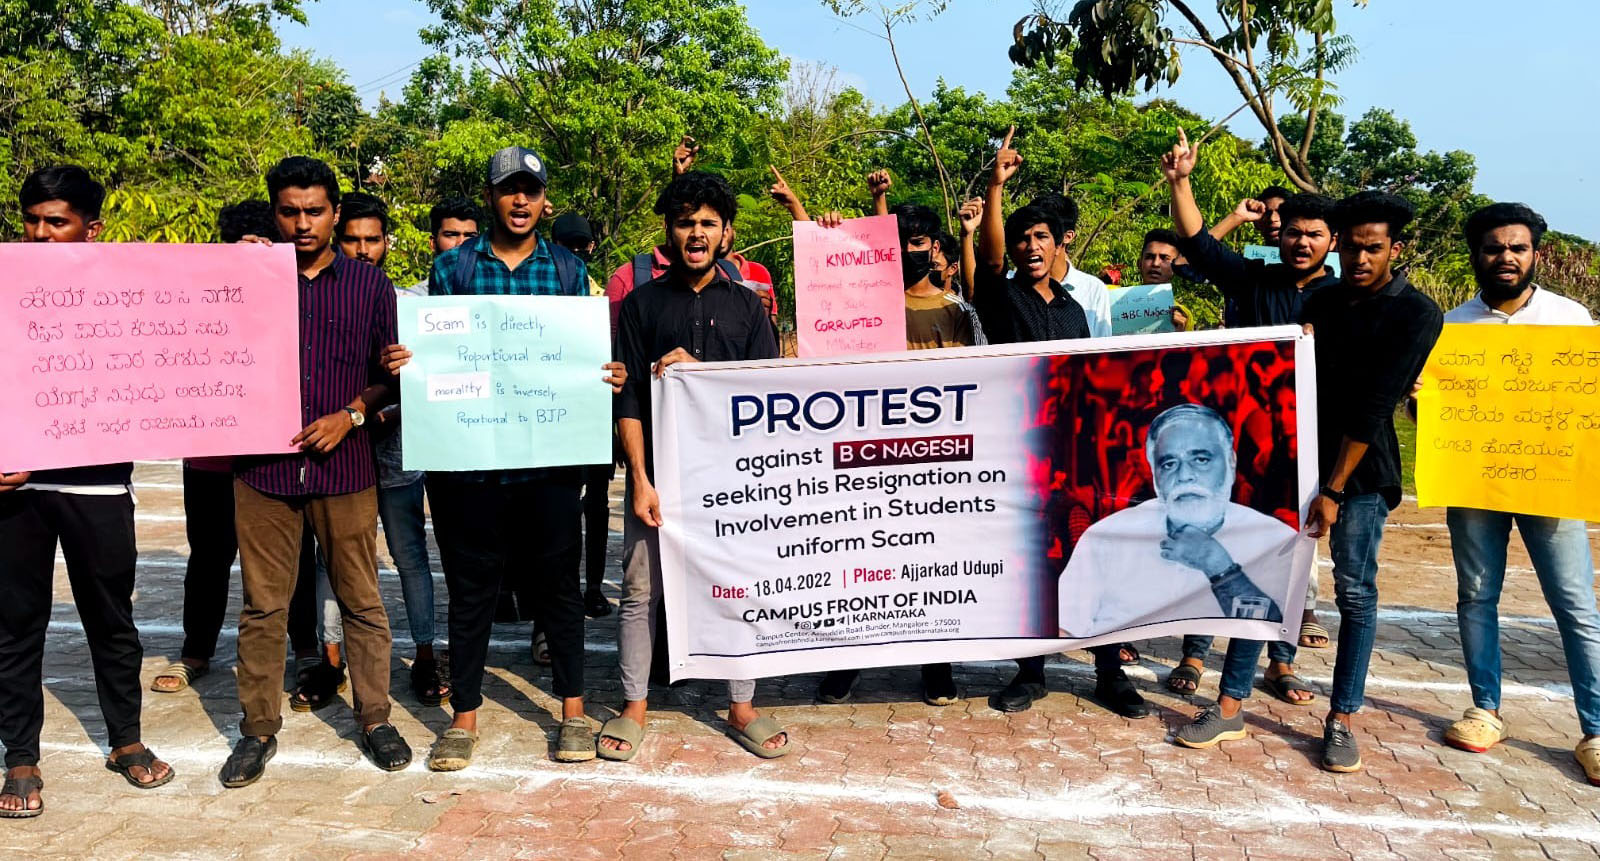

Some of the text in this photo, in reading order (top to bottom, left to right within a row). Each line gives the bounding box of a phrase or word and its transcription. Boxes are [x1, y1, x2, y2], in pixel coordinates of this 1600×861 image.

[826, 247, 897, 268] KNOWLEDGE
[424, 312, 546, 337] Scam is directly
[814, 316, 883, 332] CORRUPTED
[456, 345, 562, 371] Proportional and
[1438, 348, 1486, 367] ಮಾನ
[434, 382, 557, 402] morality is inversely
[518, 411, 529, 422] to
[536, 408, 567, 424] BJP
[730, 383, 978, 437] PROTEST
[735, 437, 970, 479] against B C NAGESH
[702, 466, 1006, 509] seeking his Resignation on
[714, 494, 997, 538] Involvement in Students
[776, 527, 936, 560] uniform Scam
[712, 585, 750, 600] Date:
[753, 571, 833, 598] 18.04.2022
[853, 566, 897, 584] Place:
[900, 560, 959, 582] Ajjarkad
[962, 559, 1004, 582] Udupi
[742, 588, 978, 624] CAMPUS FRONT OF INDIA
[852, 607, 927, 624] KARNATAKA
[755, 632, 784, 642] Campus
[892, 620, 929, 629] Mangalore
[934, 618, 961, 627] 575001
